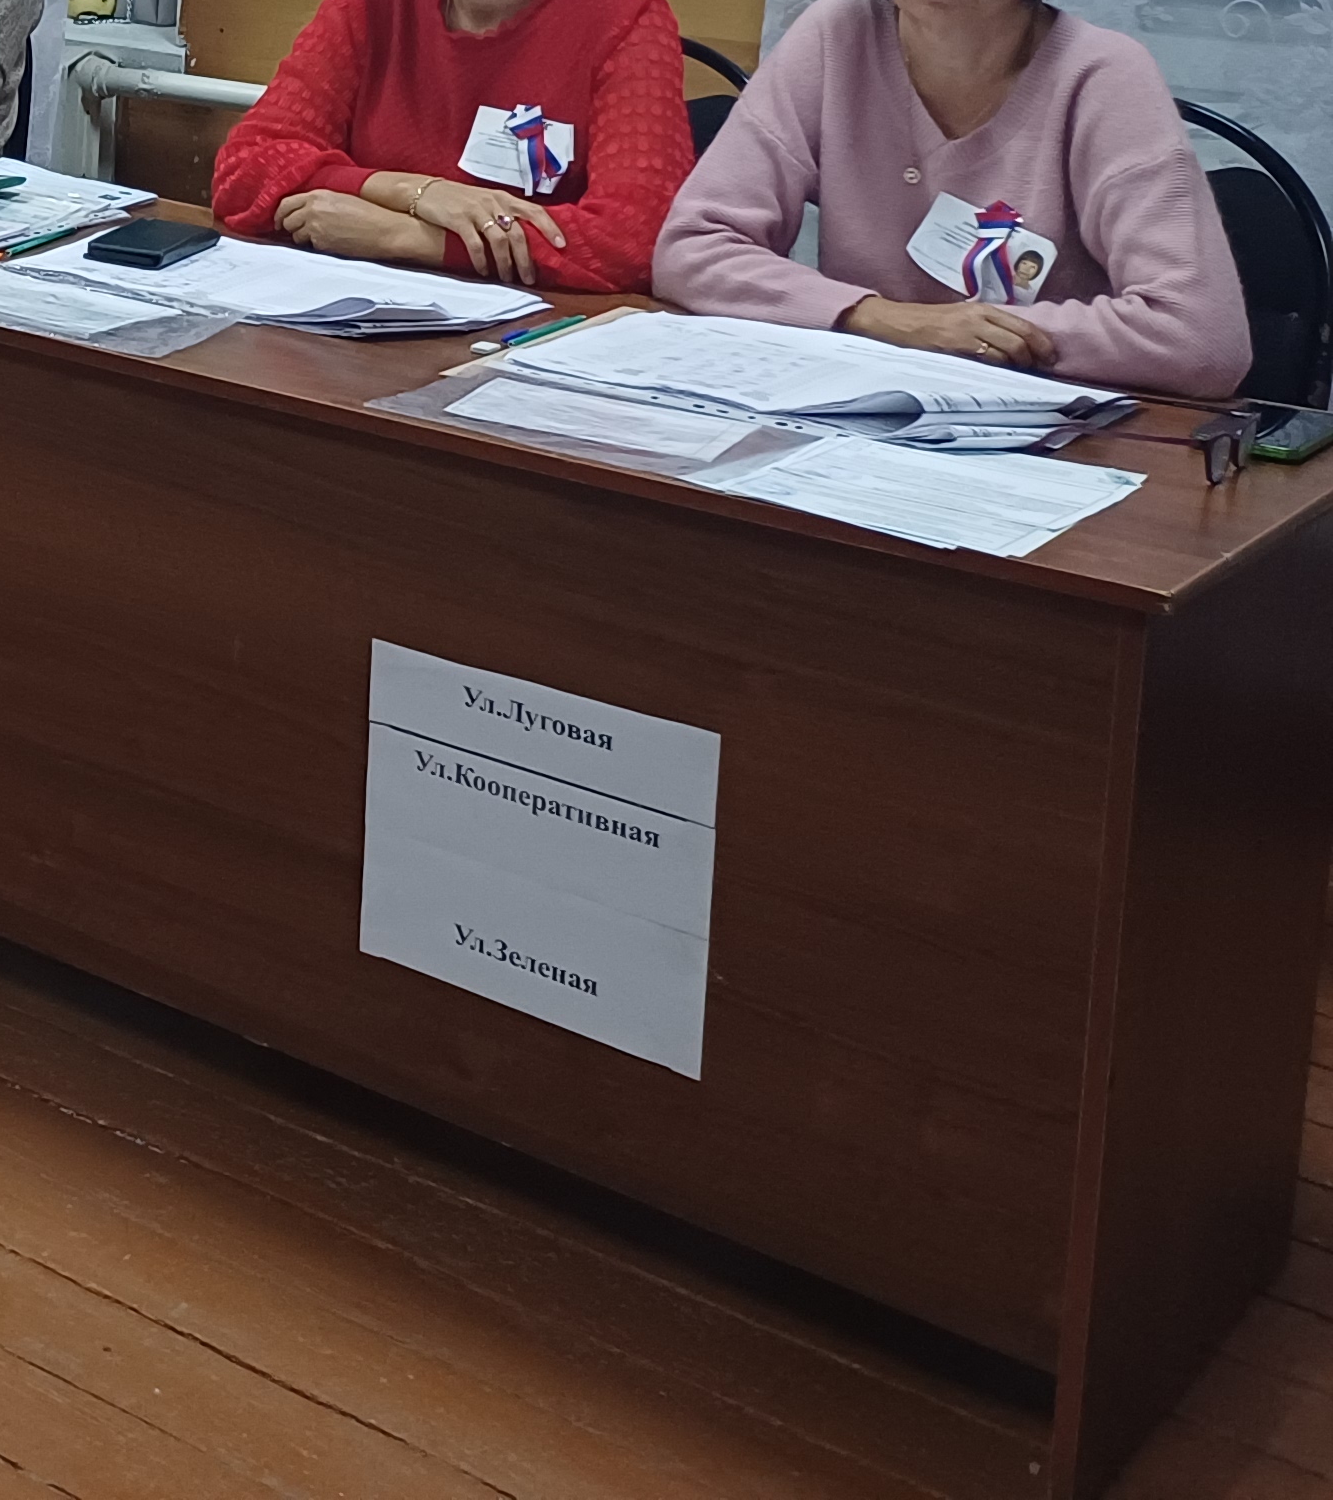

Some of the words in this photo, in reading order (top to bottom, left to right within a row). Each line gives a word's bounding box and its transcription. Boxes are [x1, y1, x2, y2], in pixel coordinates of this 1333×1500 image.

[463, 684, 614, 752] Ул.Луговая
[414, 749, 661, 849] Ул.Кооперативная
[453, 922, 598, 997] Ул.Зеленая
